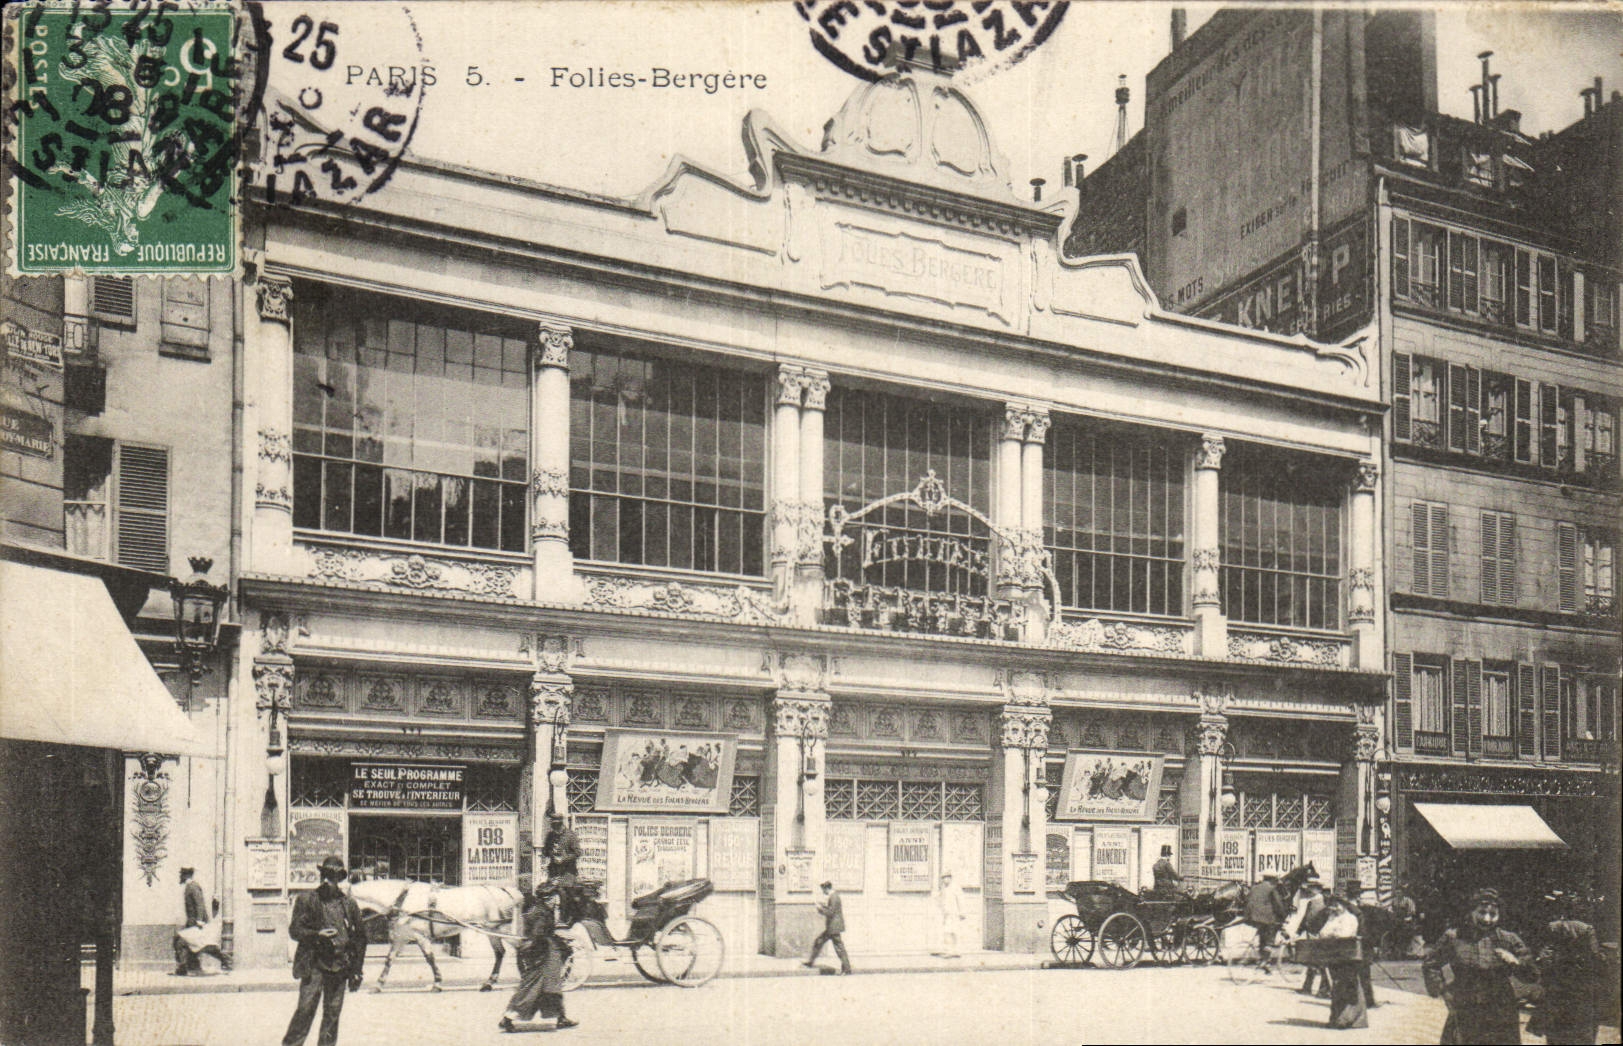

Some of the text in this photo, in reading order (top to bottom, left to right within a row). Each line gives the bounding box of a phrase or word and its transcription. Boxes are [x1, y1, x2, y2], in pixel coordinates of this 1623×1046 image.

[28, 241, 226, 262] REPUBLIQUE FRANÇAISE
[1177, 276, 1204, 302] MOTS
[1237, 243, 1351, 328] KNEIP
[354, 767, 463, 781] LE SEUL PROGRAMME
[363, 780, 395, 789] EXACT
[406, 782, 452, 790] COMPLET
[352, 789, 365, 799] SE
[366, 789, 401, 799] TROUVE
[467, 848, 514, 864] LA REVUE
[1258, 854, 1297, 873] REVUE
